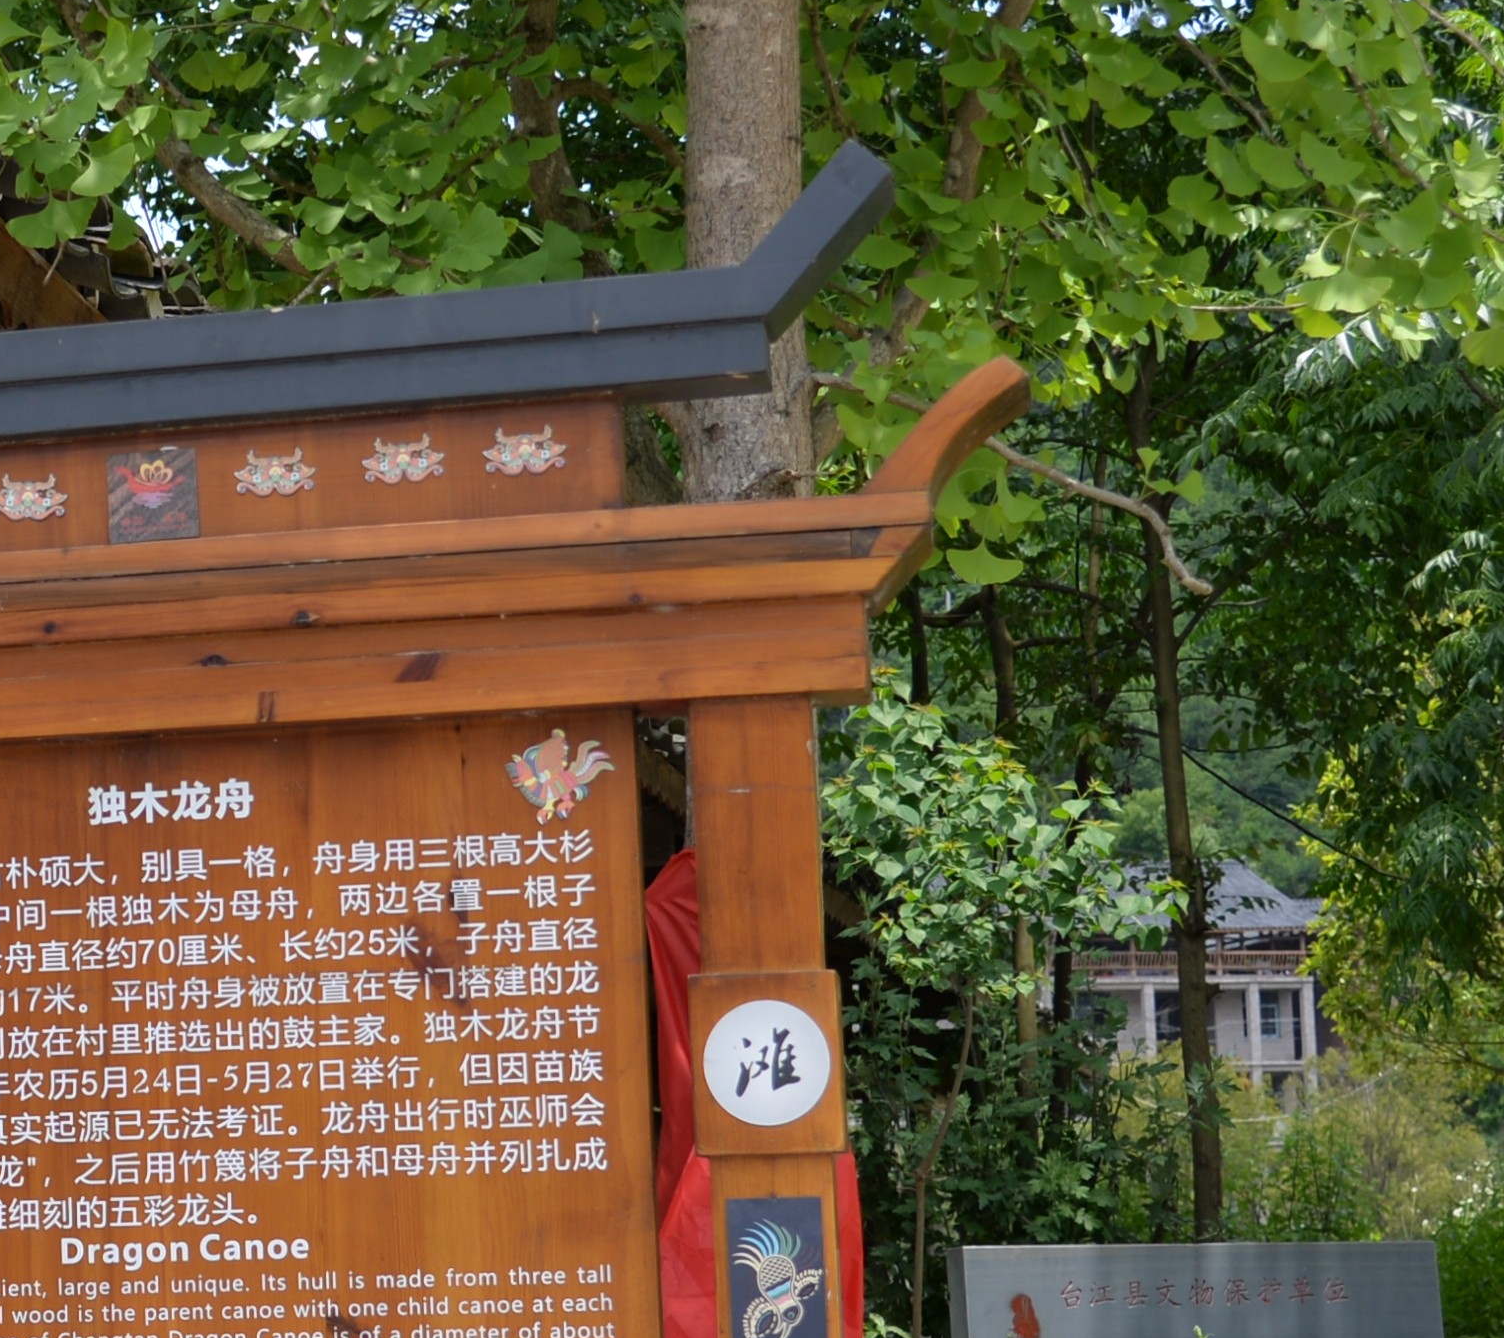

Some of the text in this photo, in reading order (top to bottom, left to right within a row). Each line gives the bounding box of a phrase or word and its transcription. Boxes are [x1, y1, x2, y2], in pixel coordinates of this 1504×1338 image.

[87, 777, 255, 826] 独木龙舟
[60, 1233, 310, 1272] Dragon Canoe
[57, 1277, 111, 1301] large
[120, 1275, 160, 1295] and
[170, 1274, 250, 1298] unique.
[261, 1273, 287, 1292] Its
[297, 1270, 338, 1291] hull
[348, 1270, 366, 1290] is
[375, 1268, 436, 1289] made
[445, 1267, 498, 1287] from
[507, 1265, 567, 1286] three
[576, 1263, 612, 1284] tall
[11, 1304, 69, 1324] wood
[77, 1304, 94, 1323] is
[101, 1303, 136, 1323] the
[144, 1303, 214, 1327] parent
[221, 1304, 286, 1320] canoe
[292, 1298, 340, 1318] with
[347, 1302, 389, 1318] one
[396, 1295, 449, 1317] child
[458, 1299, 524, 1315] canoe
[532, 1295, 554, 1314] at
[561, 1291, 614, 1313] each
